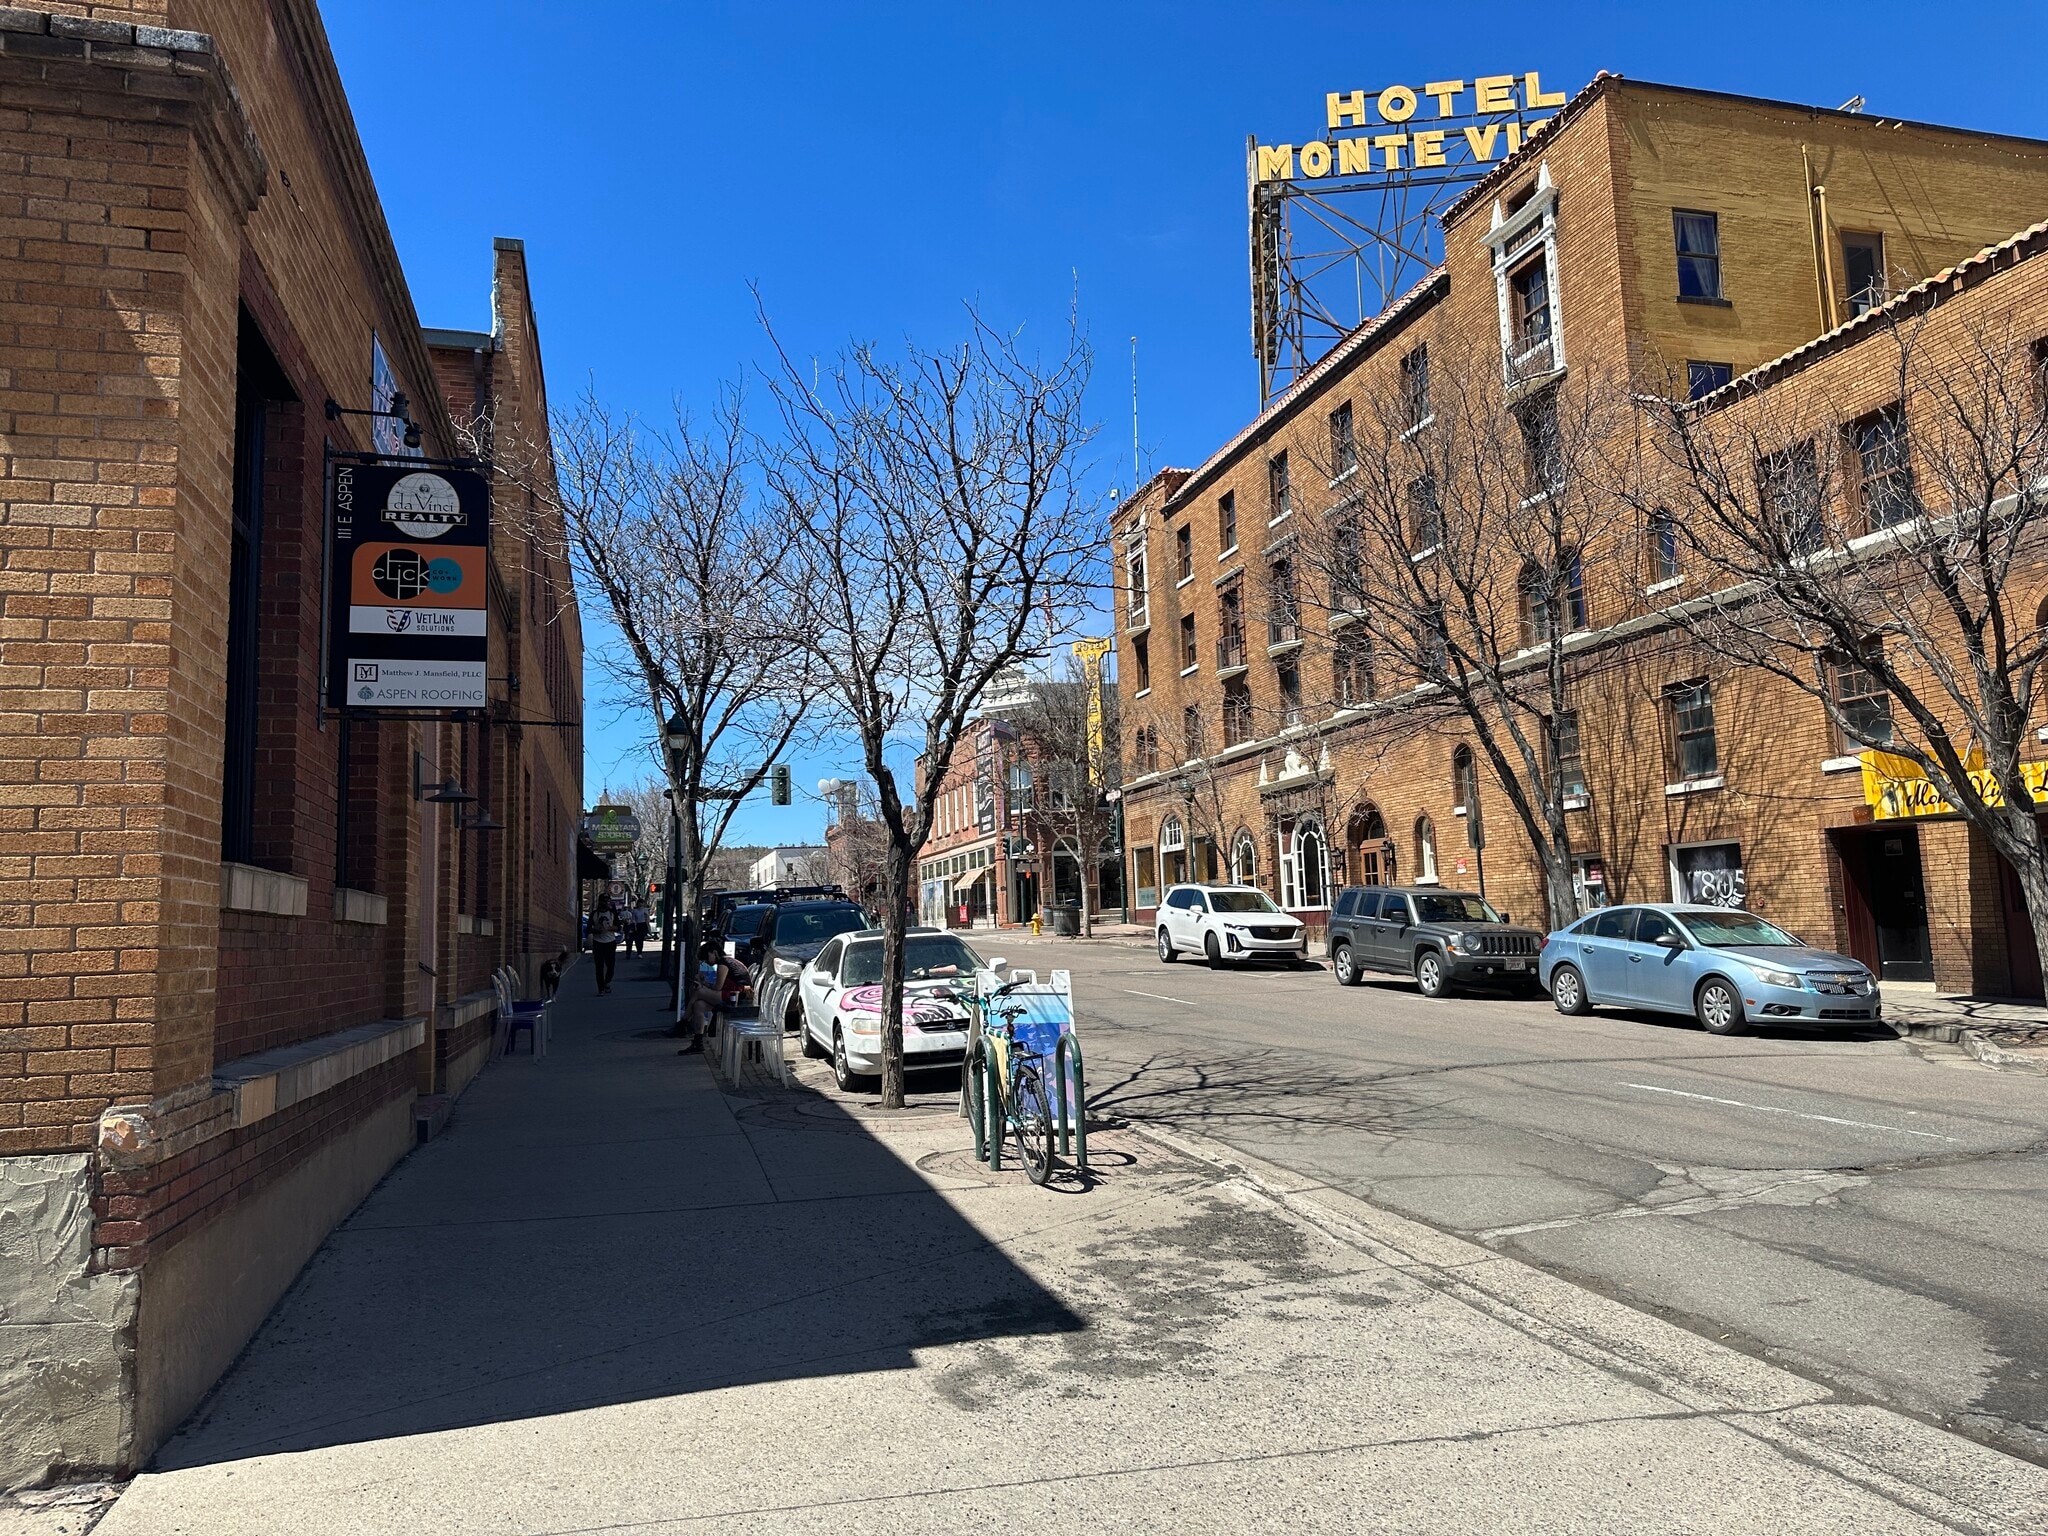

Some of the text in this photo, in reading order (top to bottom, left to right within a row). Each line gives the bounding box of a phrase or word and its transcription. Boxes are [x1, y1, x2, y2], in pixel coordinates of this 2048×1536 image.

[1326, 71, 1566, 128] HOTEL
[1257, 130, 1446, 181] MONTE
[337, 467, 353, 511] ASPEN
[394, 493, 454, 512] da Vinci
[337, 515, 352, 524] E
[384, 511, 464, 523] REALTY
[381, 669, 414, 677] Matthew
[423, 670, 460, 678] Mansfield,
[462, 670, 482, 678] PLLC
[377, 688, 483, 700] ASPEN ROOFING
[591, 823, 638, 831] MOUNTAIN
[597, 831, 632, 839] SPORTS
[1701, 869, 1746, 900] 805
